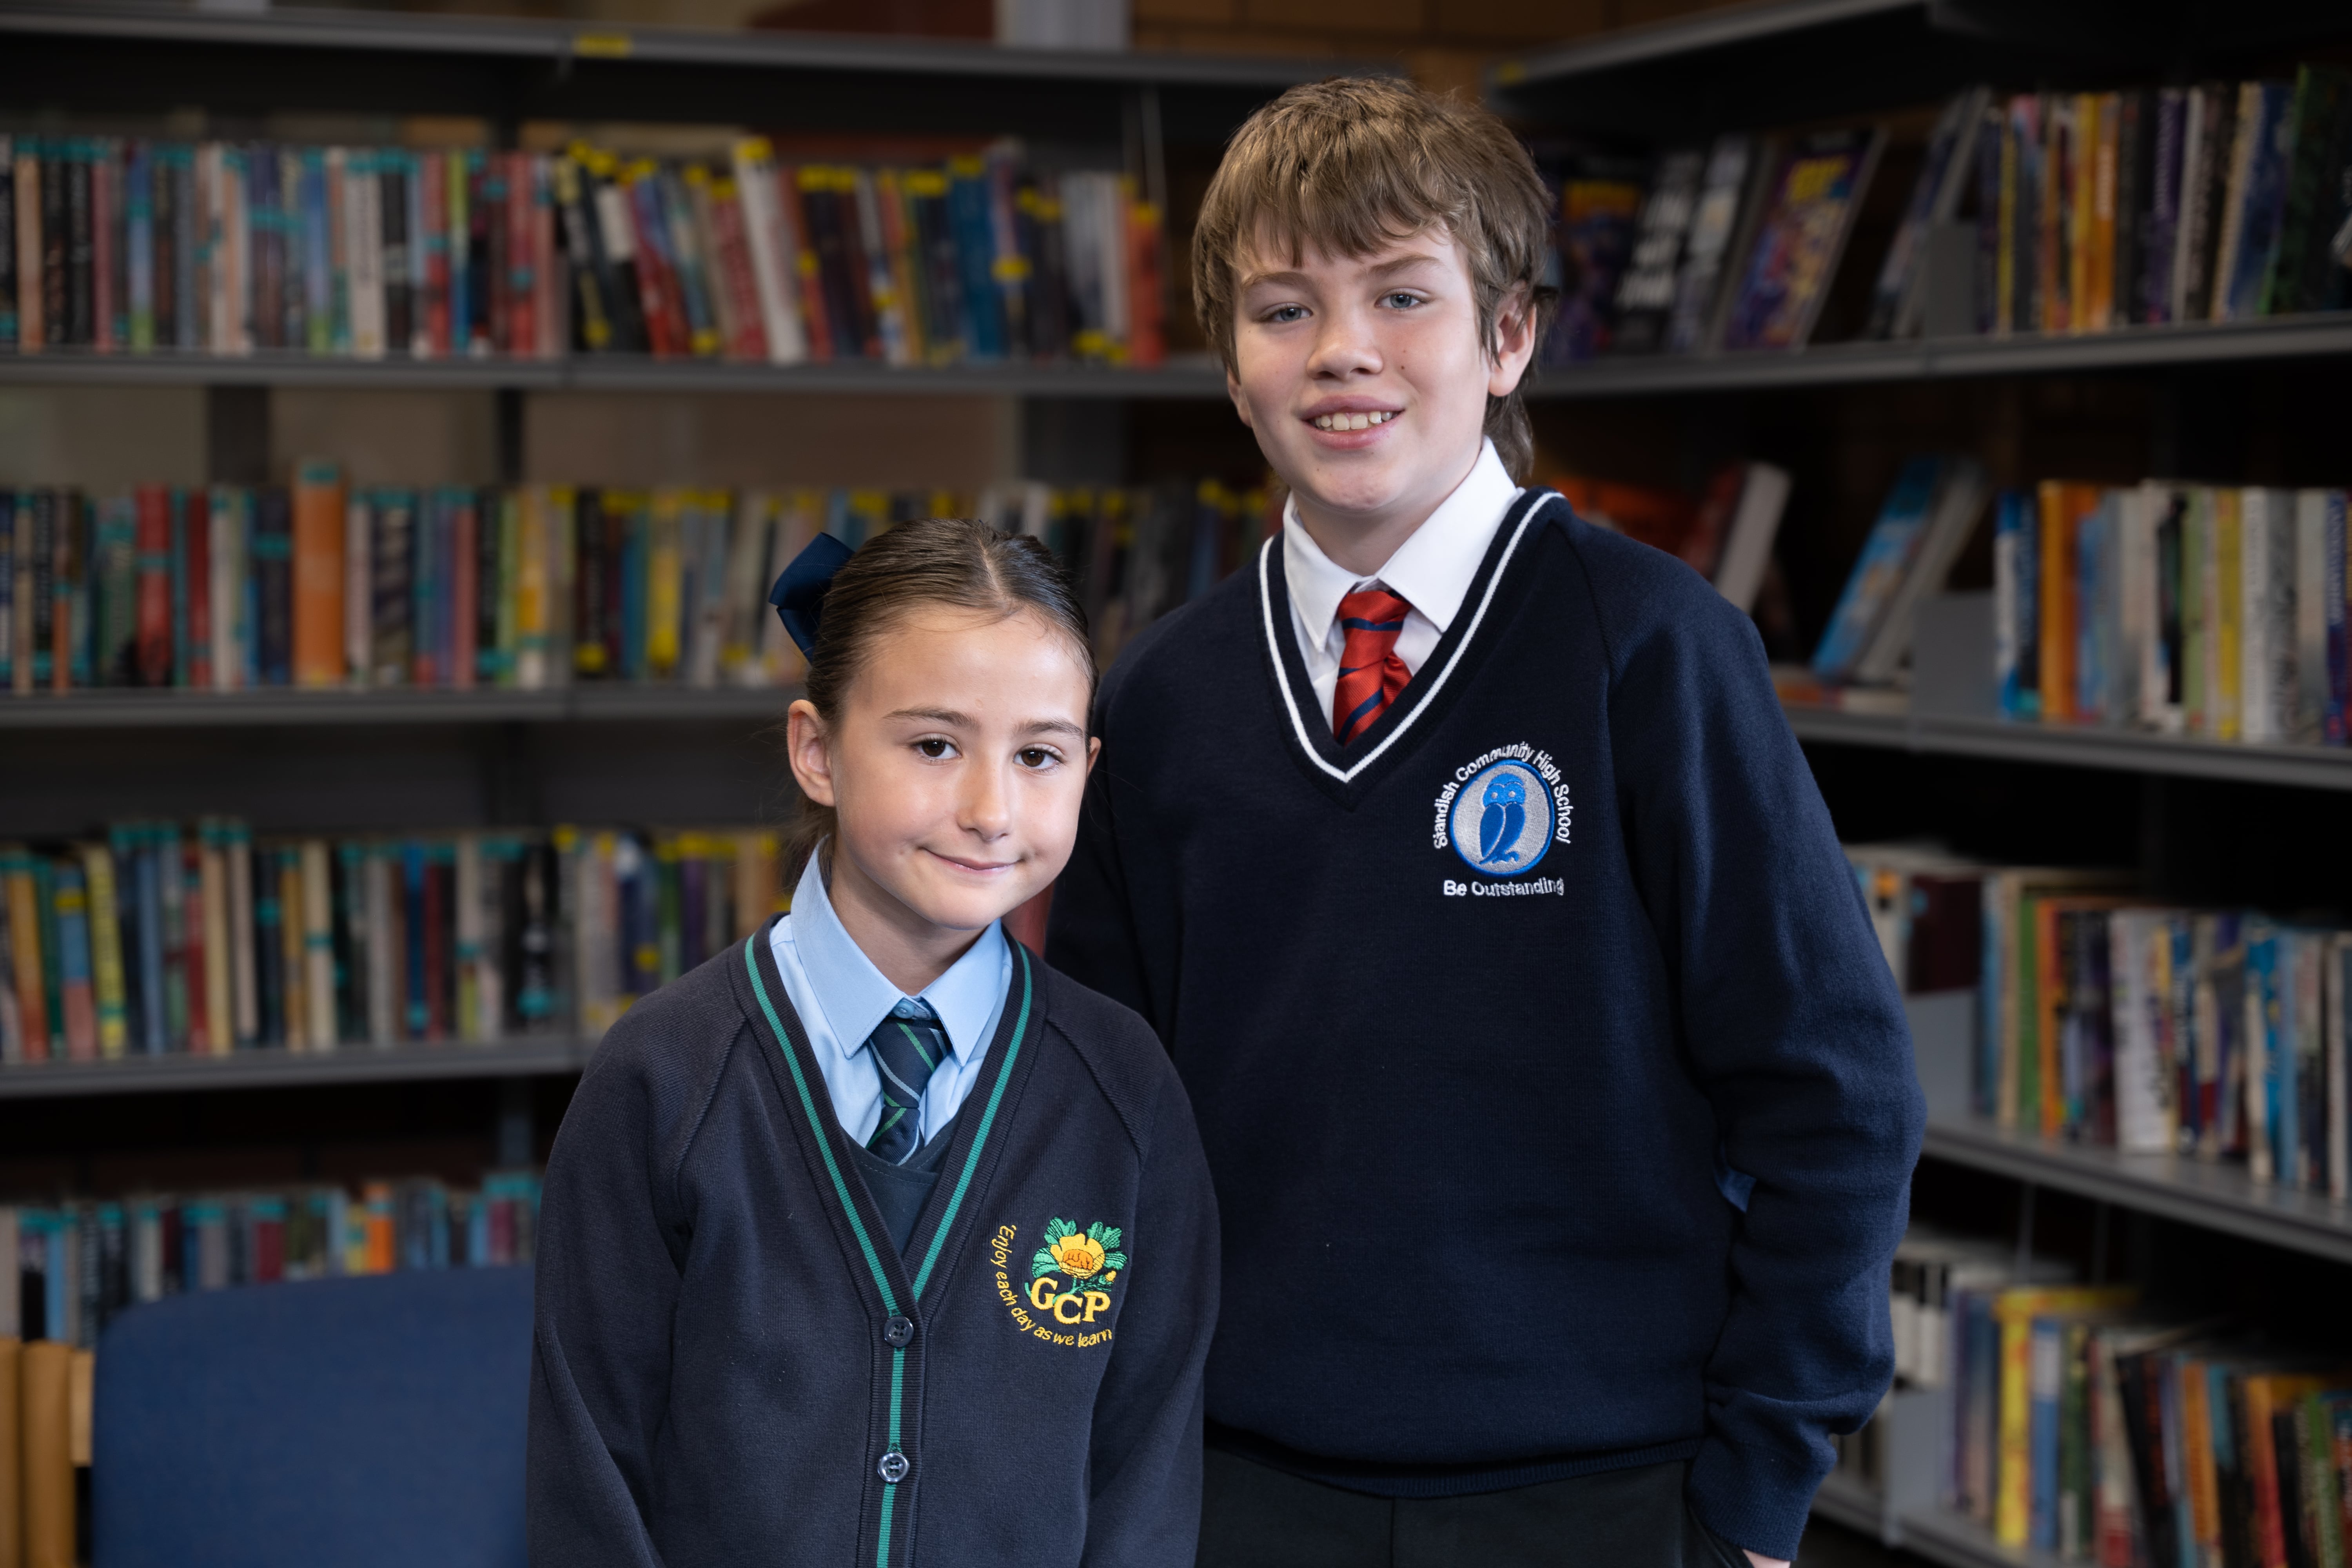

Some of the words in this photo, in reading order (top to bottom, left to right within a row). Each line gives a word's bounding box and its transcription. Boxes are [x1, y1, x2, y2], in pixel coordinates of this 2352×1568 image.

[1433, 782, 1459, 849] Standish
[1455, 741, 1535, 781] Community
[1533, 750, 1561, 785] High
[1553, 784, 1573, 844] School
[1443, 880, 1467, 897] Be
[1471, 877, 1564, 897] Outstanding
[996, 1271, 1018, 1306] each
[1011, 1308, 1036, 1331] day
[1034, 1327, 1053, 1340] as
[1054, 1333, 1074, 1345] we
[1031, 1277, 1111, 1324] GCP
